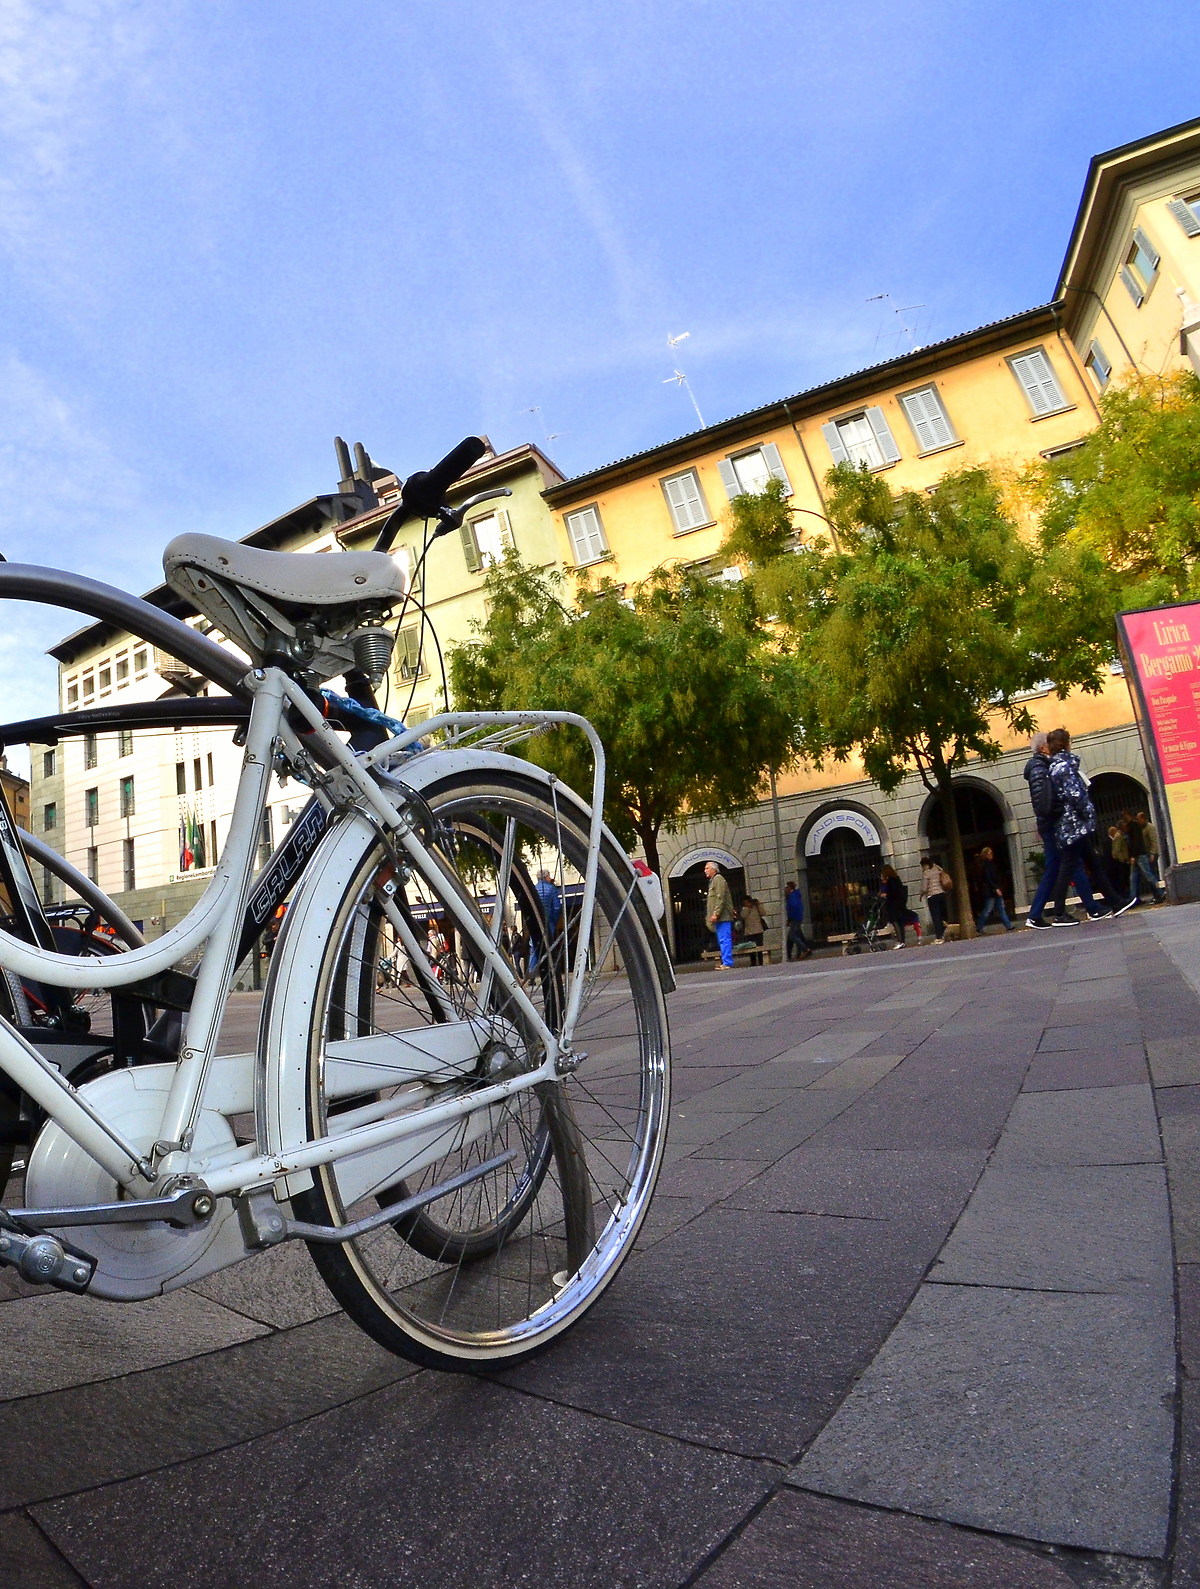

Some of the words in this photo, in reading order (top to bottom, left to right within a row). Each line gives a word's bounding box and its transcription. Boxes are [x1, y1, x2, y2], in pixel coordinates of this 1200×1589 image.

[1153, 620, 1191, 646] Lirica
[1140, 653, 1194, 680] Bergamo
[810, 814, 875, 854] LANDISPORT
[250, 803, 325, 924] GALAN
